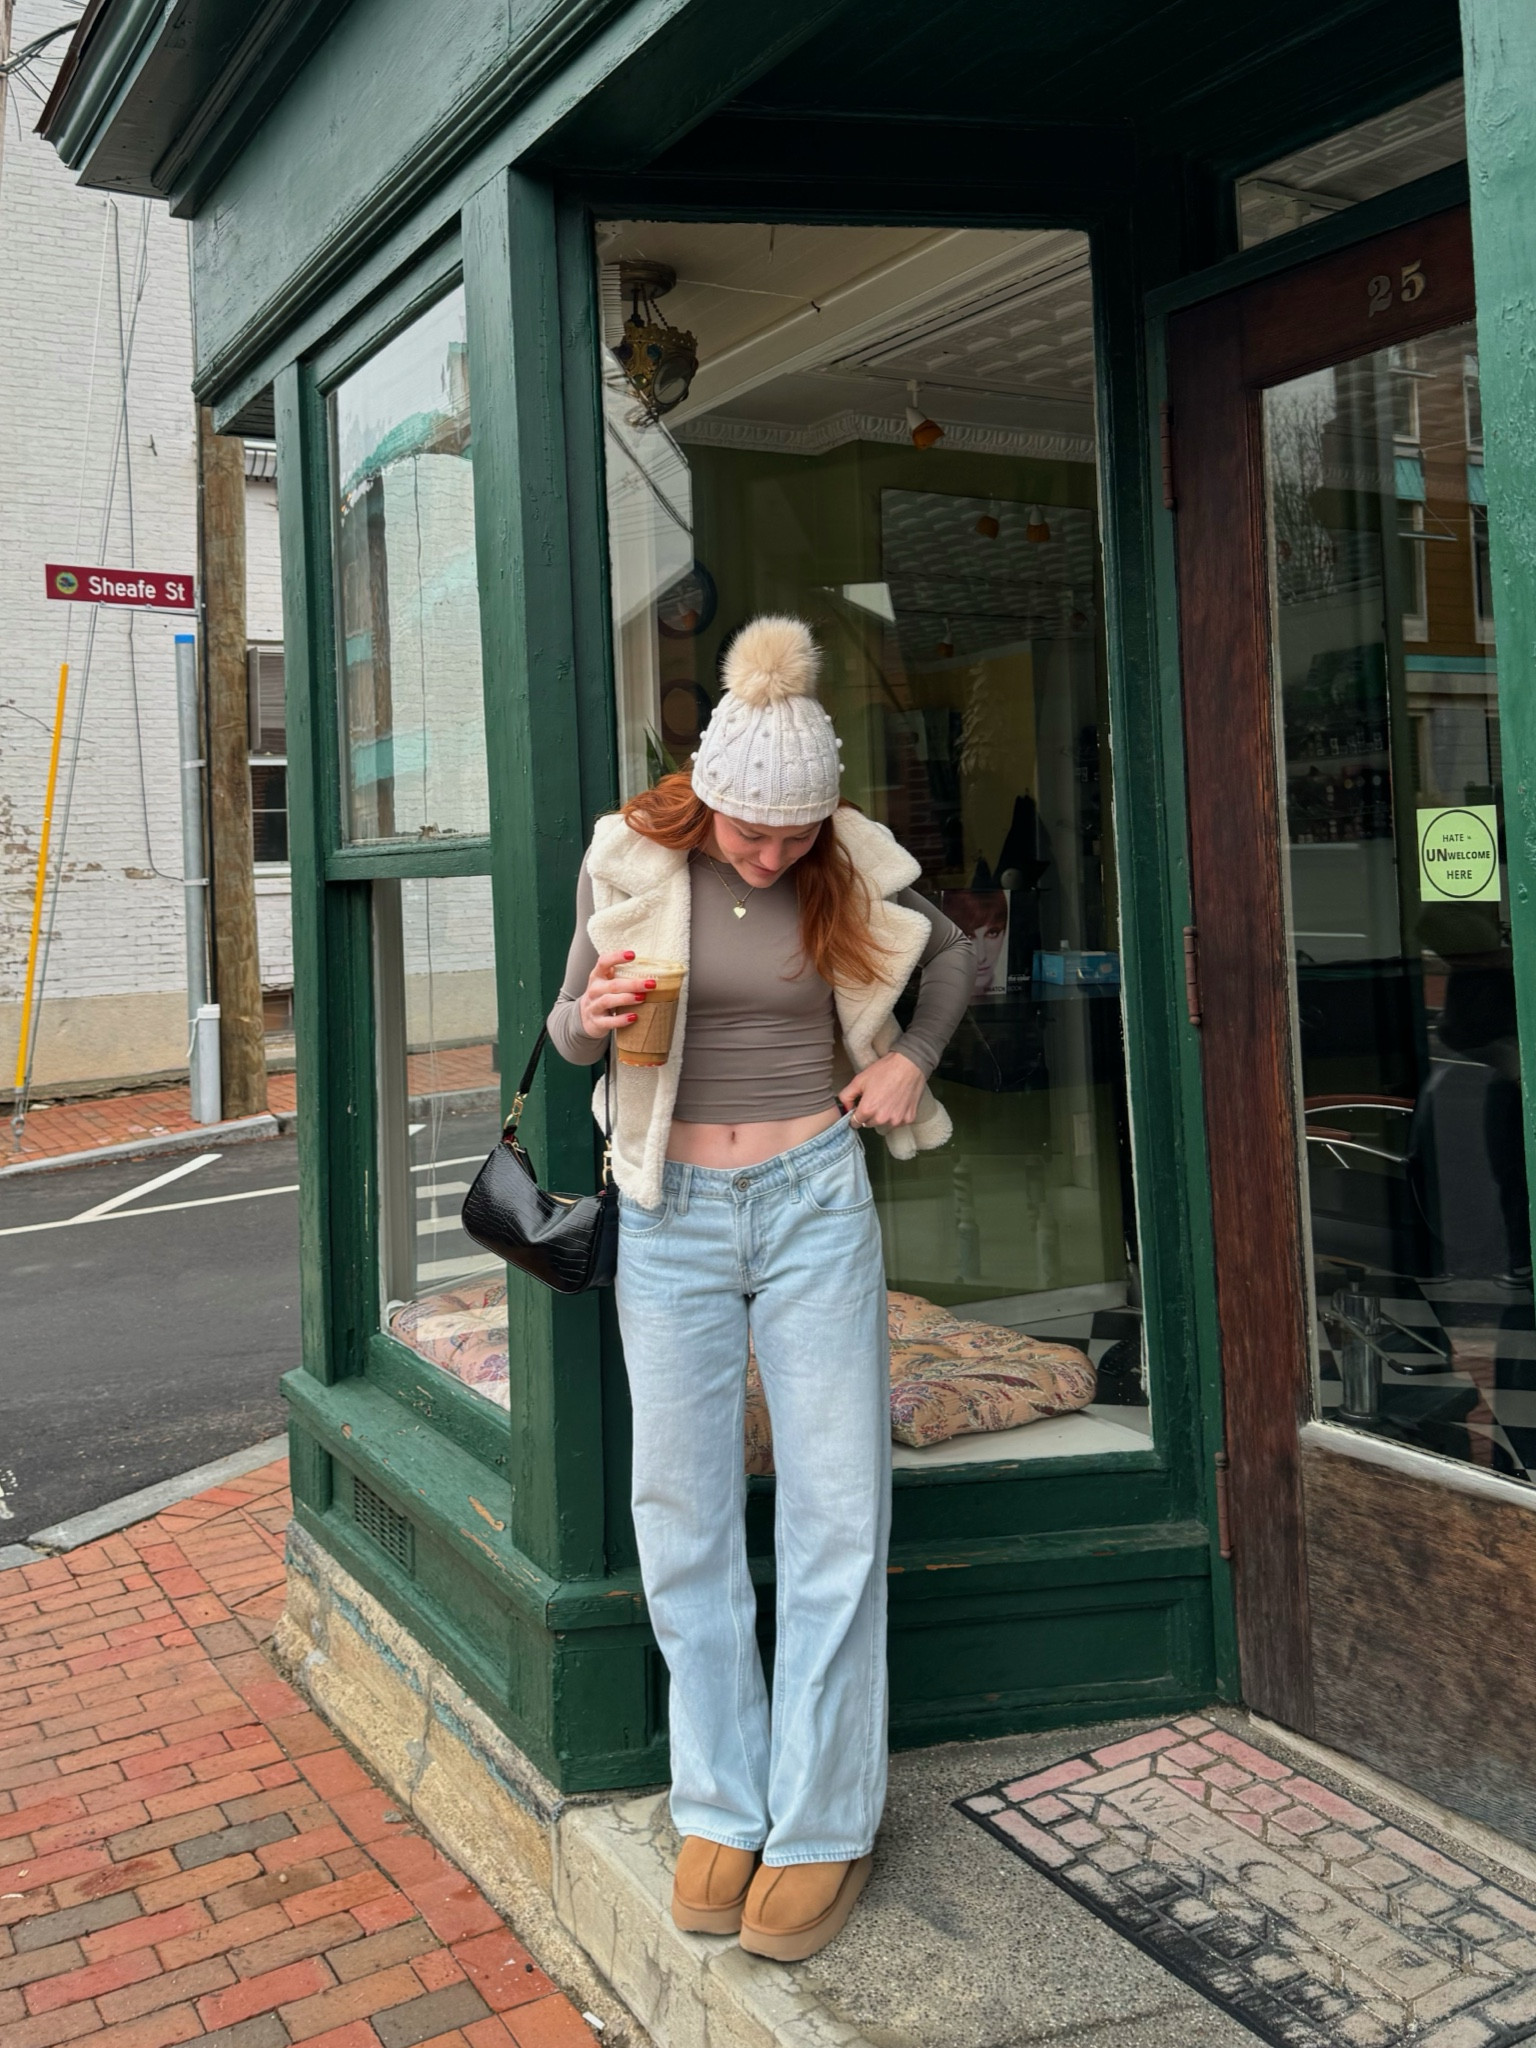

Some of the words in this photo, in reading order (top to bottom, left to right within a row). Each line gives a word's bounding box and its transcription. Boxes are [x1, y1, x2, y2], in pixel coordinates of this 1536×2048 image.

[1367, 259, 1426, 318] 25
[88, 575, 157, 599] Sheafe
[165, 581, 186, 601] St
[1442, 833, 1465, 843] HATE
[1426, 848, 1491, 862] UNWELCOME
[1446, 869, 1473, 880] HERE
[1129, 1786, 1429, 1986] WELCOME
